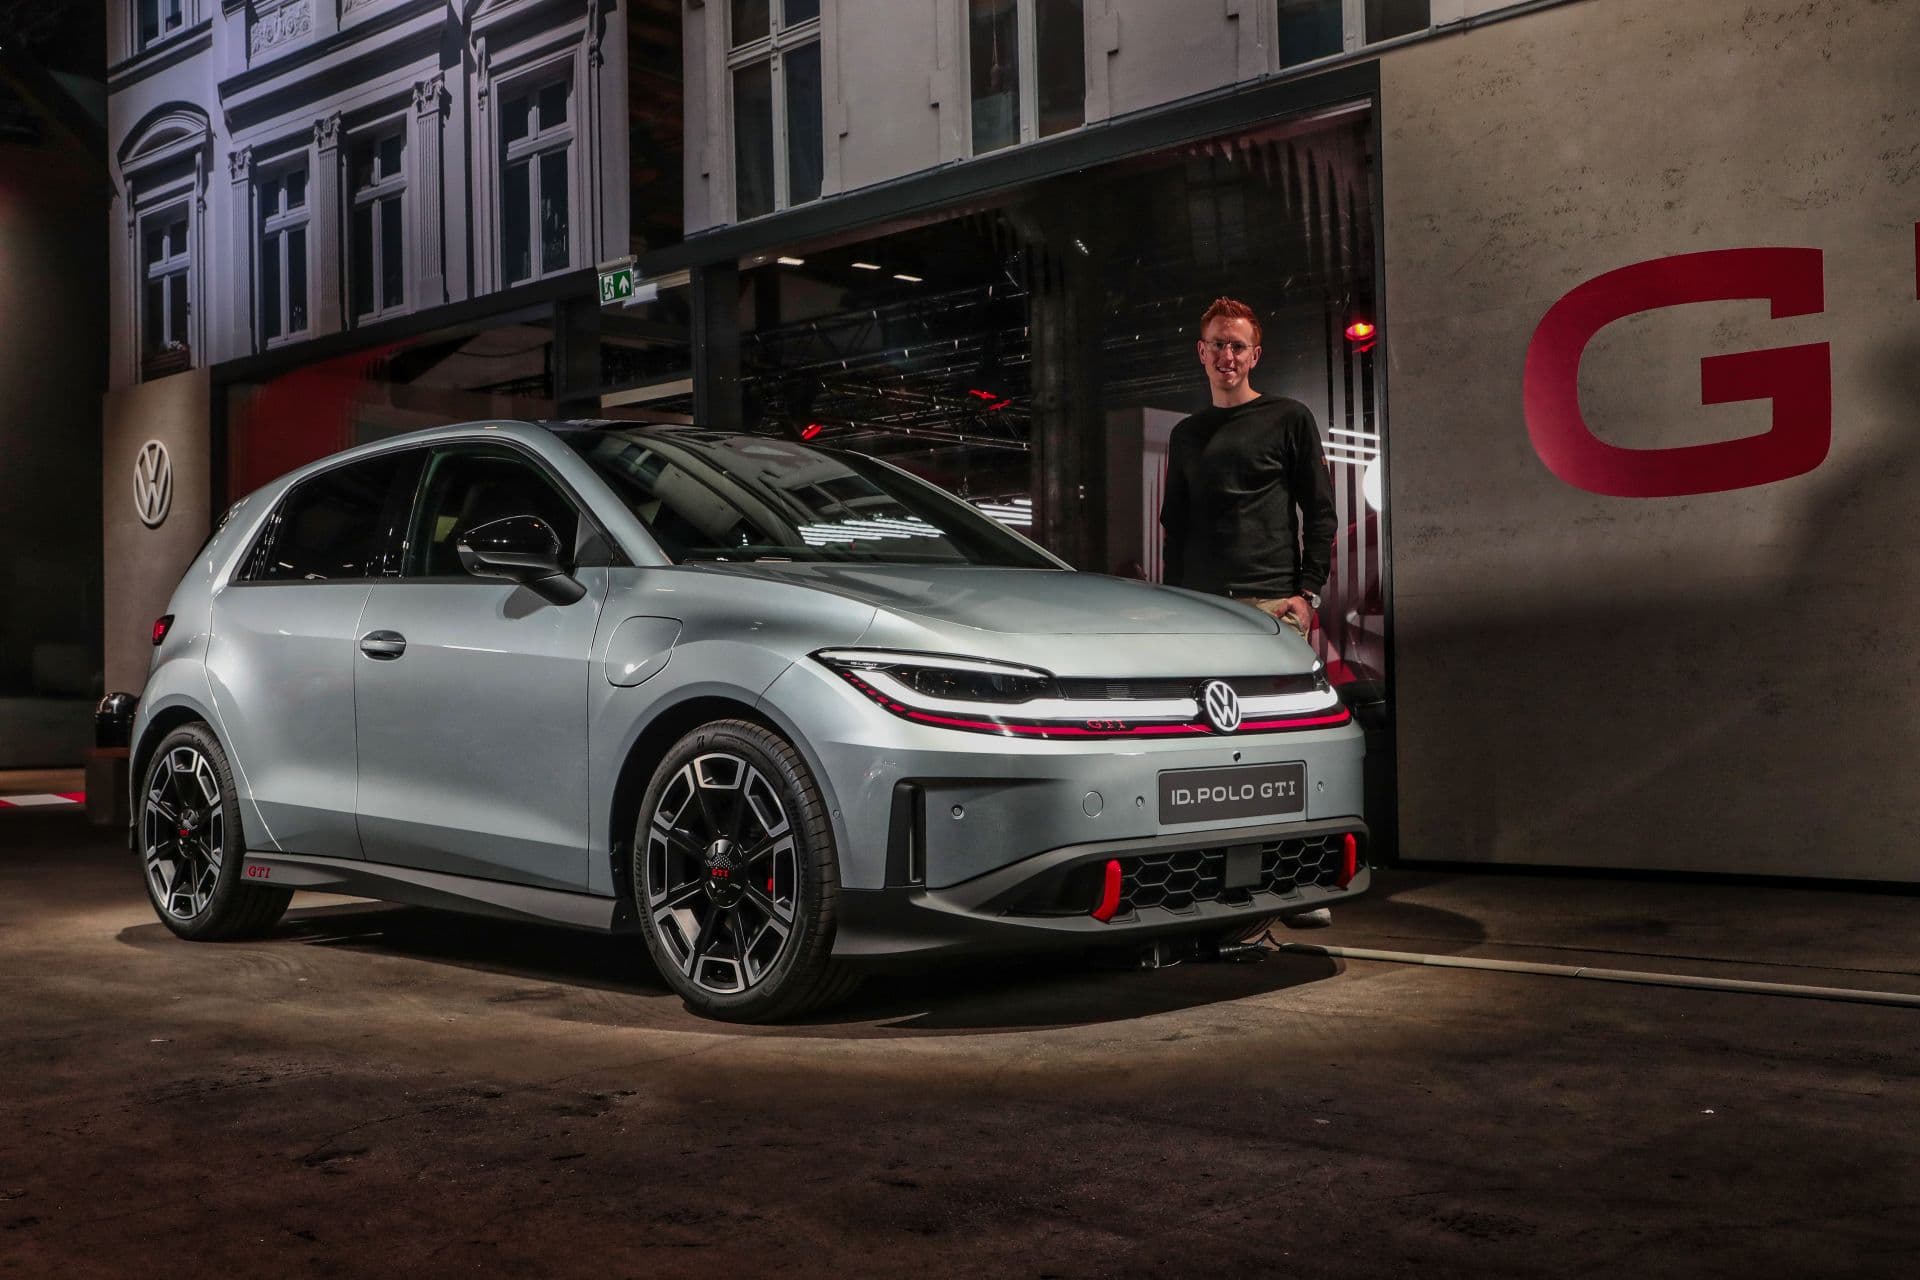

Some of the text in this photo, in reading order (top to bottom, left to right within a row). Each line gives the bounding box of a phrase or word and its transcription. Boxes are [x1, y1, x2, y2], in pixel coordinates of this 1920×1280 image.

[1522, 222, 1920, 499] G
[1087, 719, 1126, 730] GTI
[1260, 780, 1296, 799] GTI
[247, 865, 271, 879] GTI
